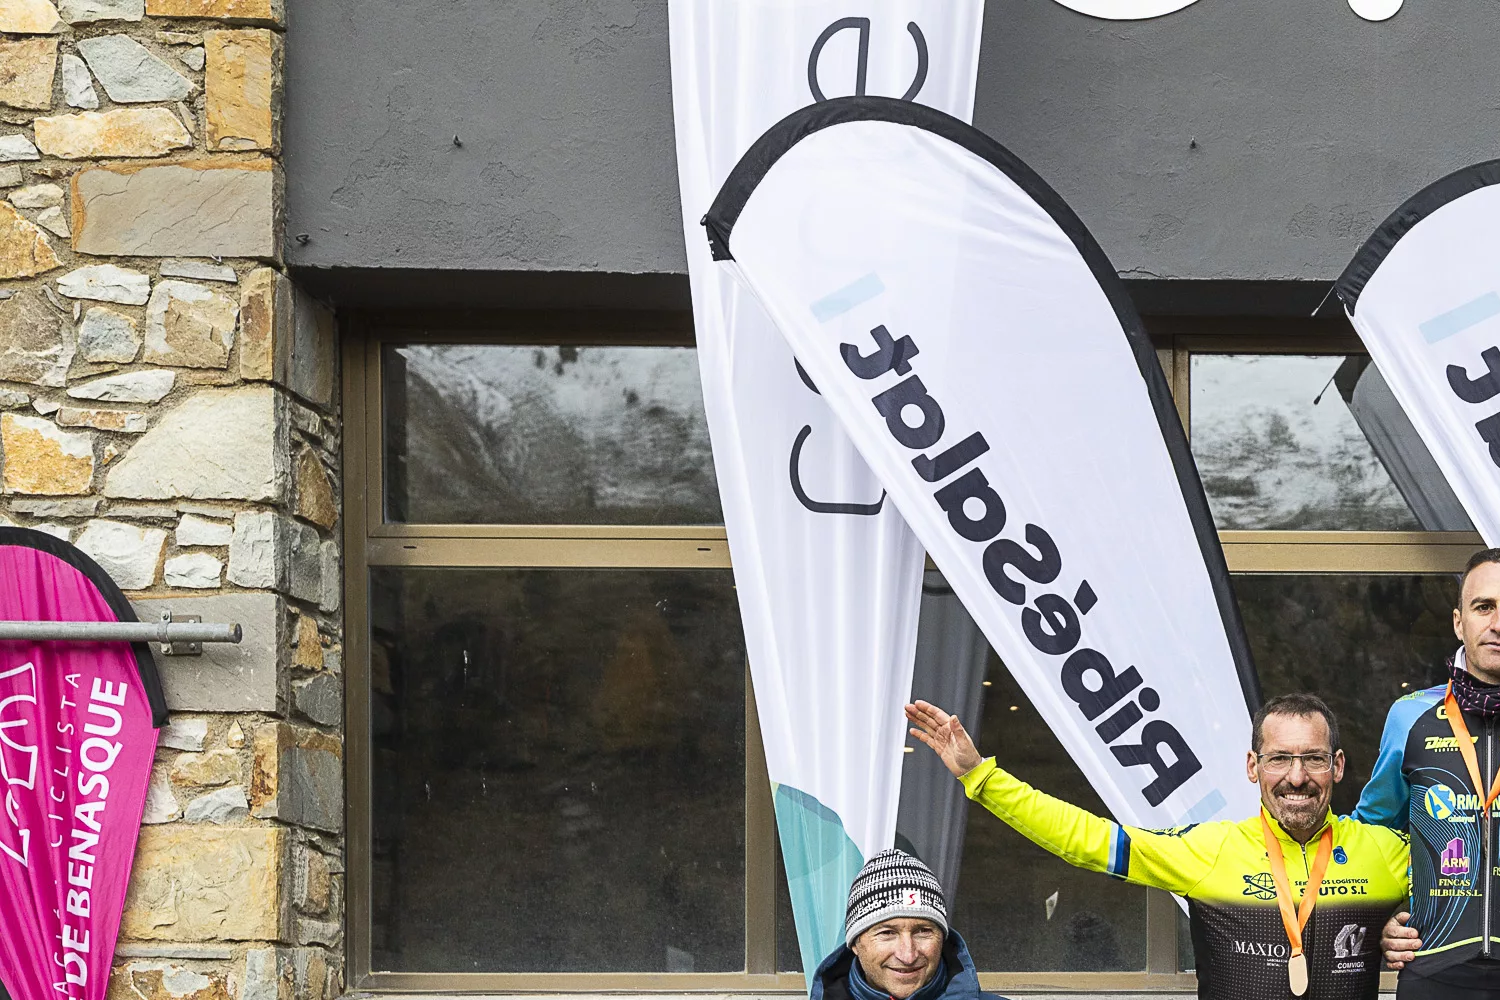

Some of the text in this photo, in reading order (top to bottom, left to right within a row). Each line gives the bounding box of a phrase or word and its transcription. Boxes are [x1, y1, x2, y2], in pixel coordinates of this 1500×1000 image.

[66, 677, 128, 919] BENASQUE
[1442, 858, 1469, 868] ARM
[1438, 878, 1471, 887] FINCAS
[1299, 885, 1348, 897] SUTO
